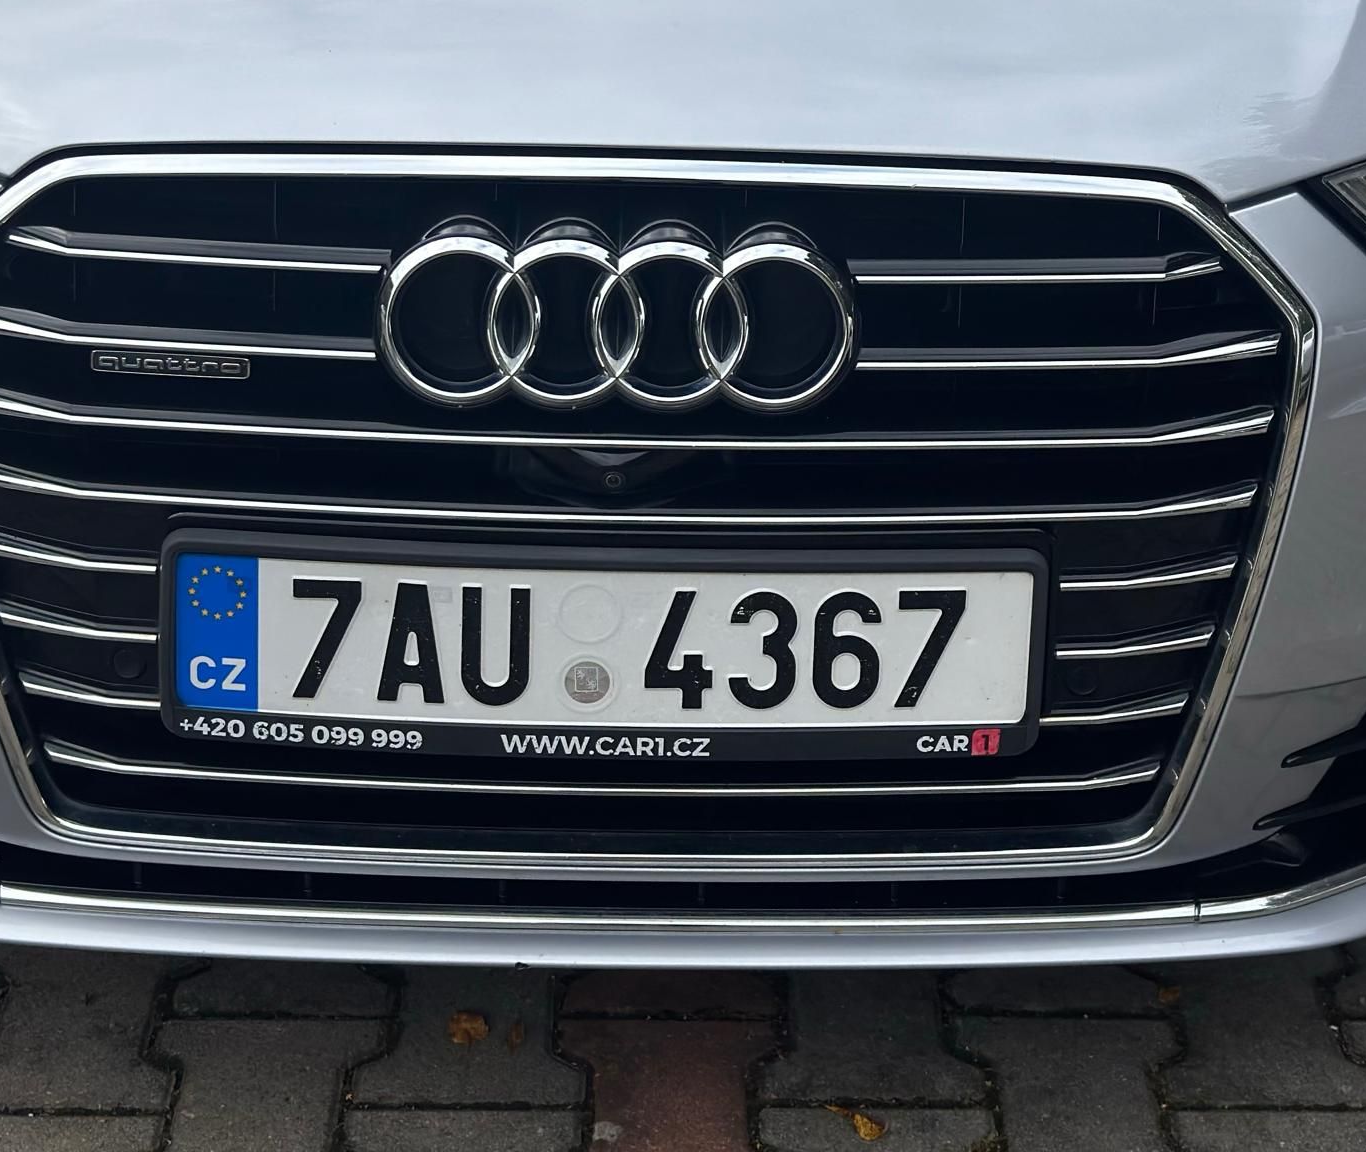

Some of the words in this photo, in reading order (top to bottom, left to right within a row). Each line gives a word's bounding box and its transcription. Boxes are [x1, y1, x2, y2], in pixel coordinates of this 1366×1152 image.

[98, 355, 241, 374] quattro
[292, 578, 532, 707] 7AU
[644, 589, 968, 710] 4367
[188, 655, 247, 692] CZ
[179, 716, 246, 738] +420
[252, 721, 305, 743] 605
[311, 725, 365, 746] 099
[371, 729, 423, 749] 999
[500, 734, 711, 757] WWW.CAR1.CZ
